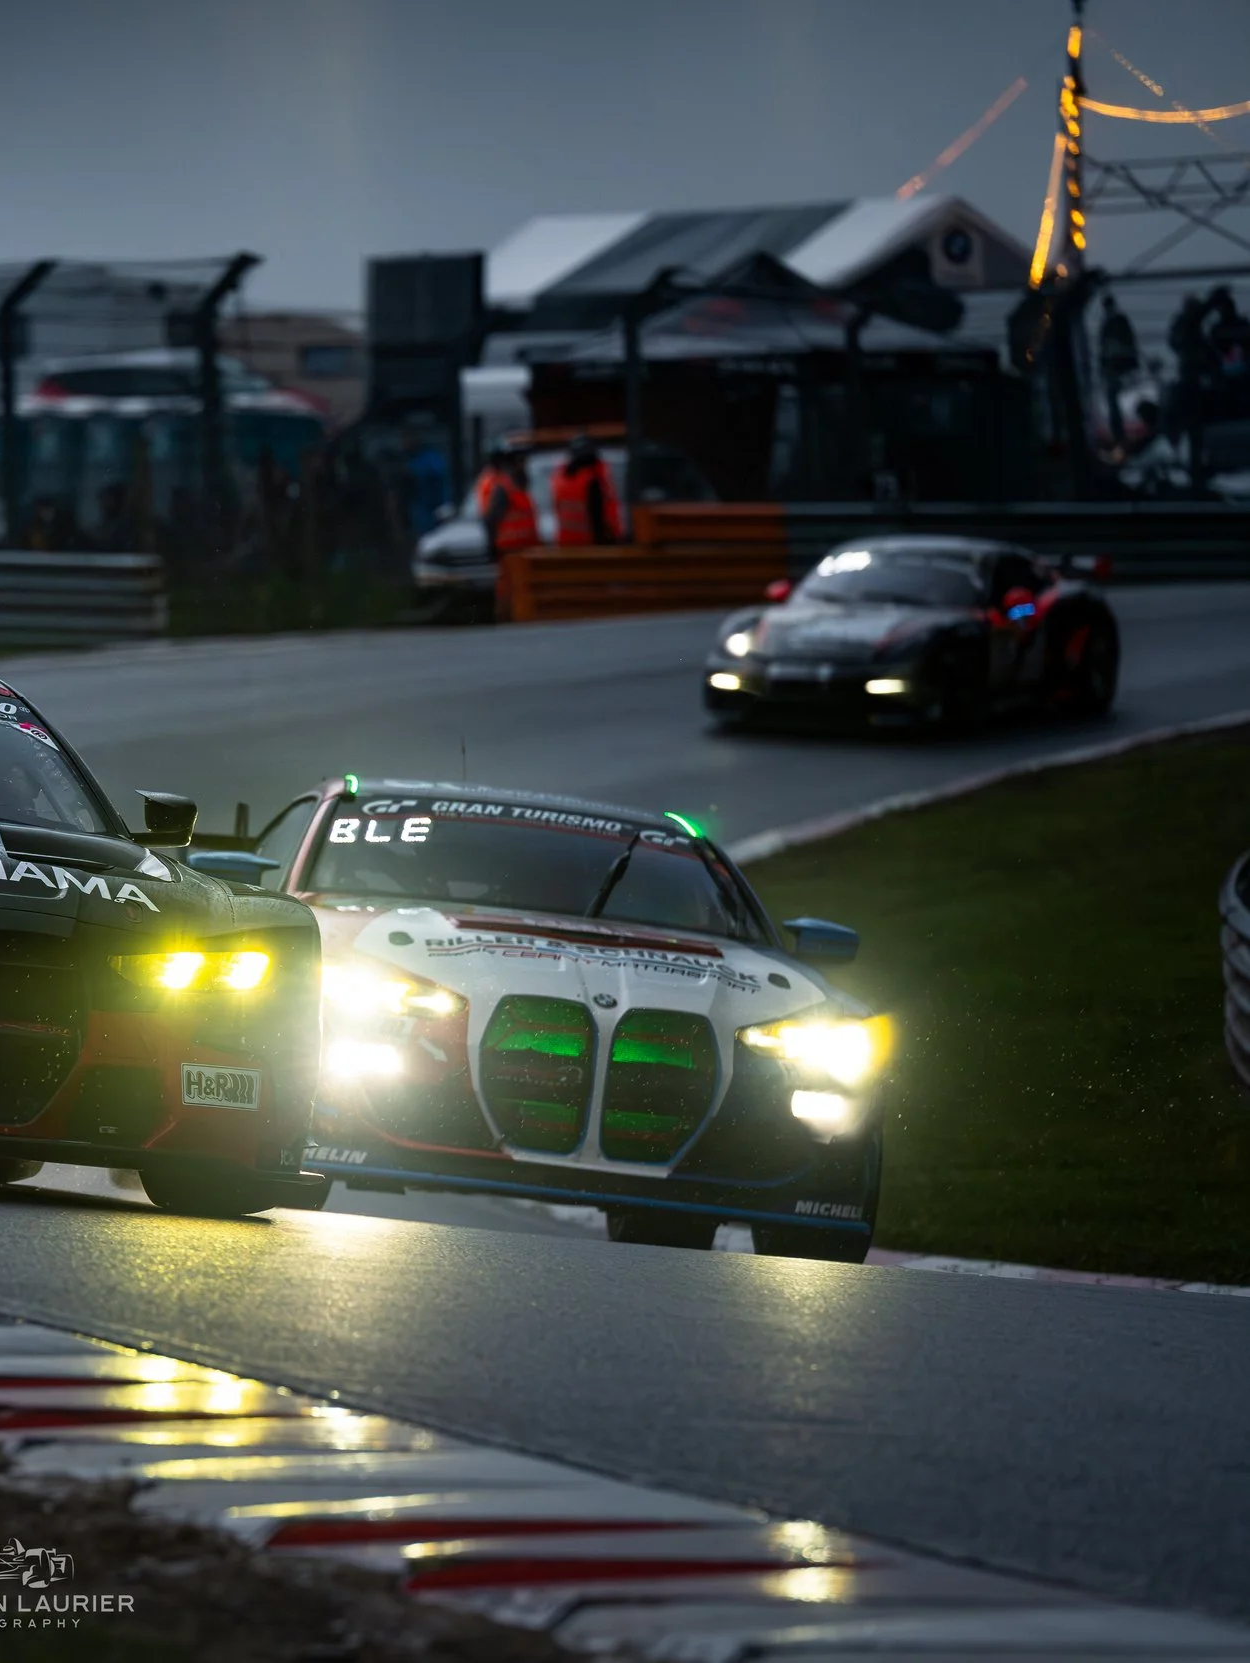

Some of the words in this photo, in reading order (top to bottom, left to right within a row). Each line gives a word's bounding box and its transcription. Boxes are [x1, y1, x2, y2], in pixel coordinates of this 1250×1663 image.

[431, 801, 504, 816] GRAN
[511, 807, 622, 832] TURISMO
[329, 817, 432, 843] BLE
[426, 936, 534, 947] RILLER
[184, 1069, 231, 1102] H&R
[303, 1147, 368, 1165] HELIN
[795, 1200, 863, 1220] MICHEL
